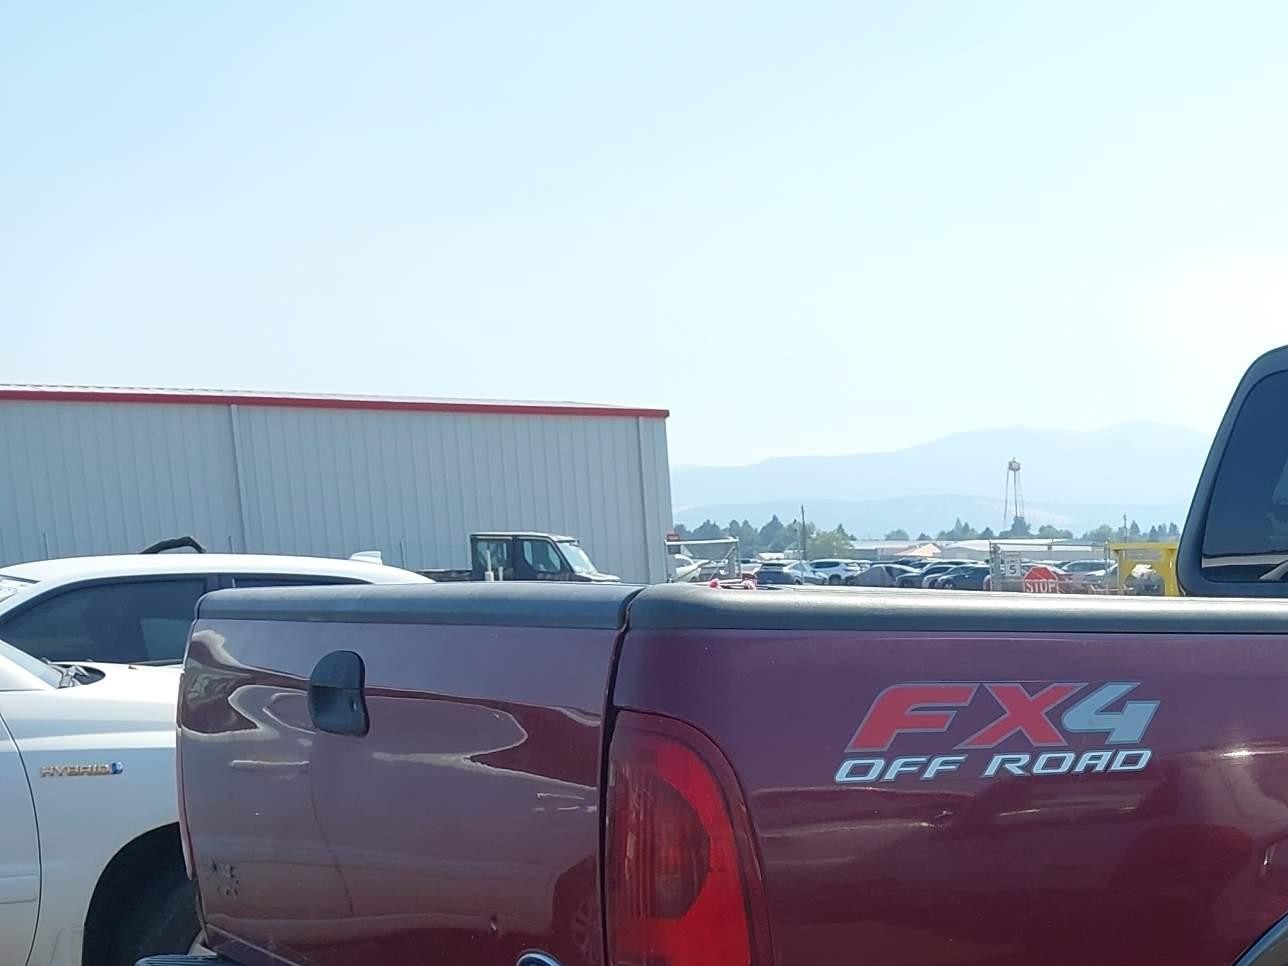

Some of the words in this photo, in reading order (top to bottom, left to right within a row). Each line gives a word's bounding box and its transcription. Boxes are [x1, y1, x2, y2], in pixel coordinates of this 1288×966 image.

[1025, 581, 1056, 593] STOP
[844, 682, 1160, 753] FX4
[40, 763, 110, 778] HYBRID
[835, 753, 968, 783] OFF
[980, 749, 1153, 778] ROAD
